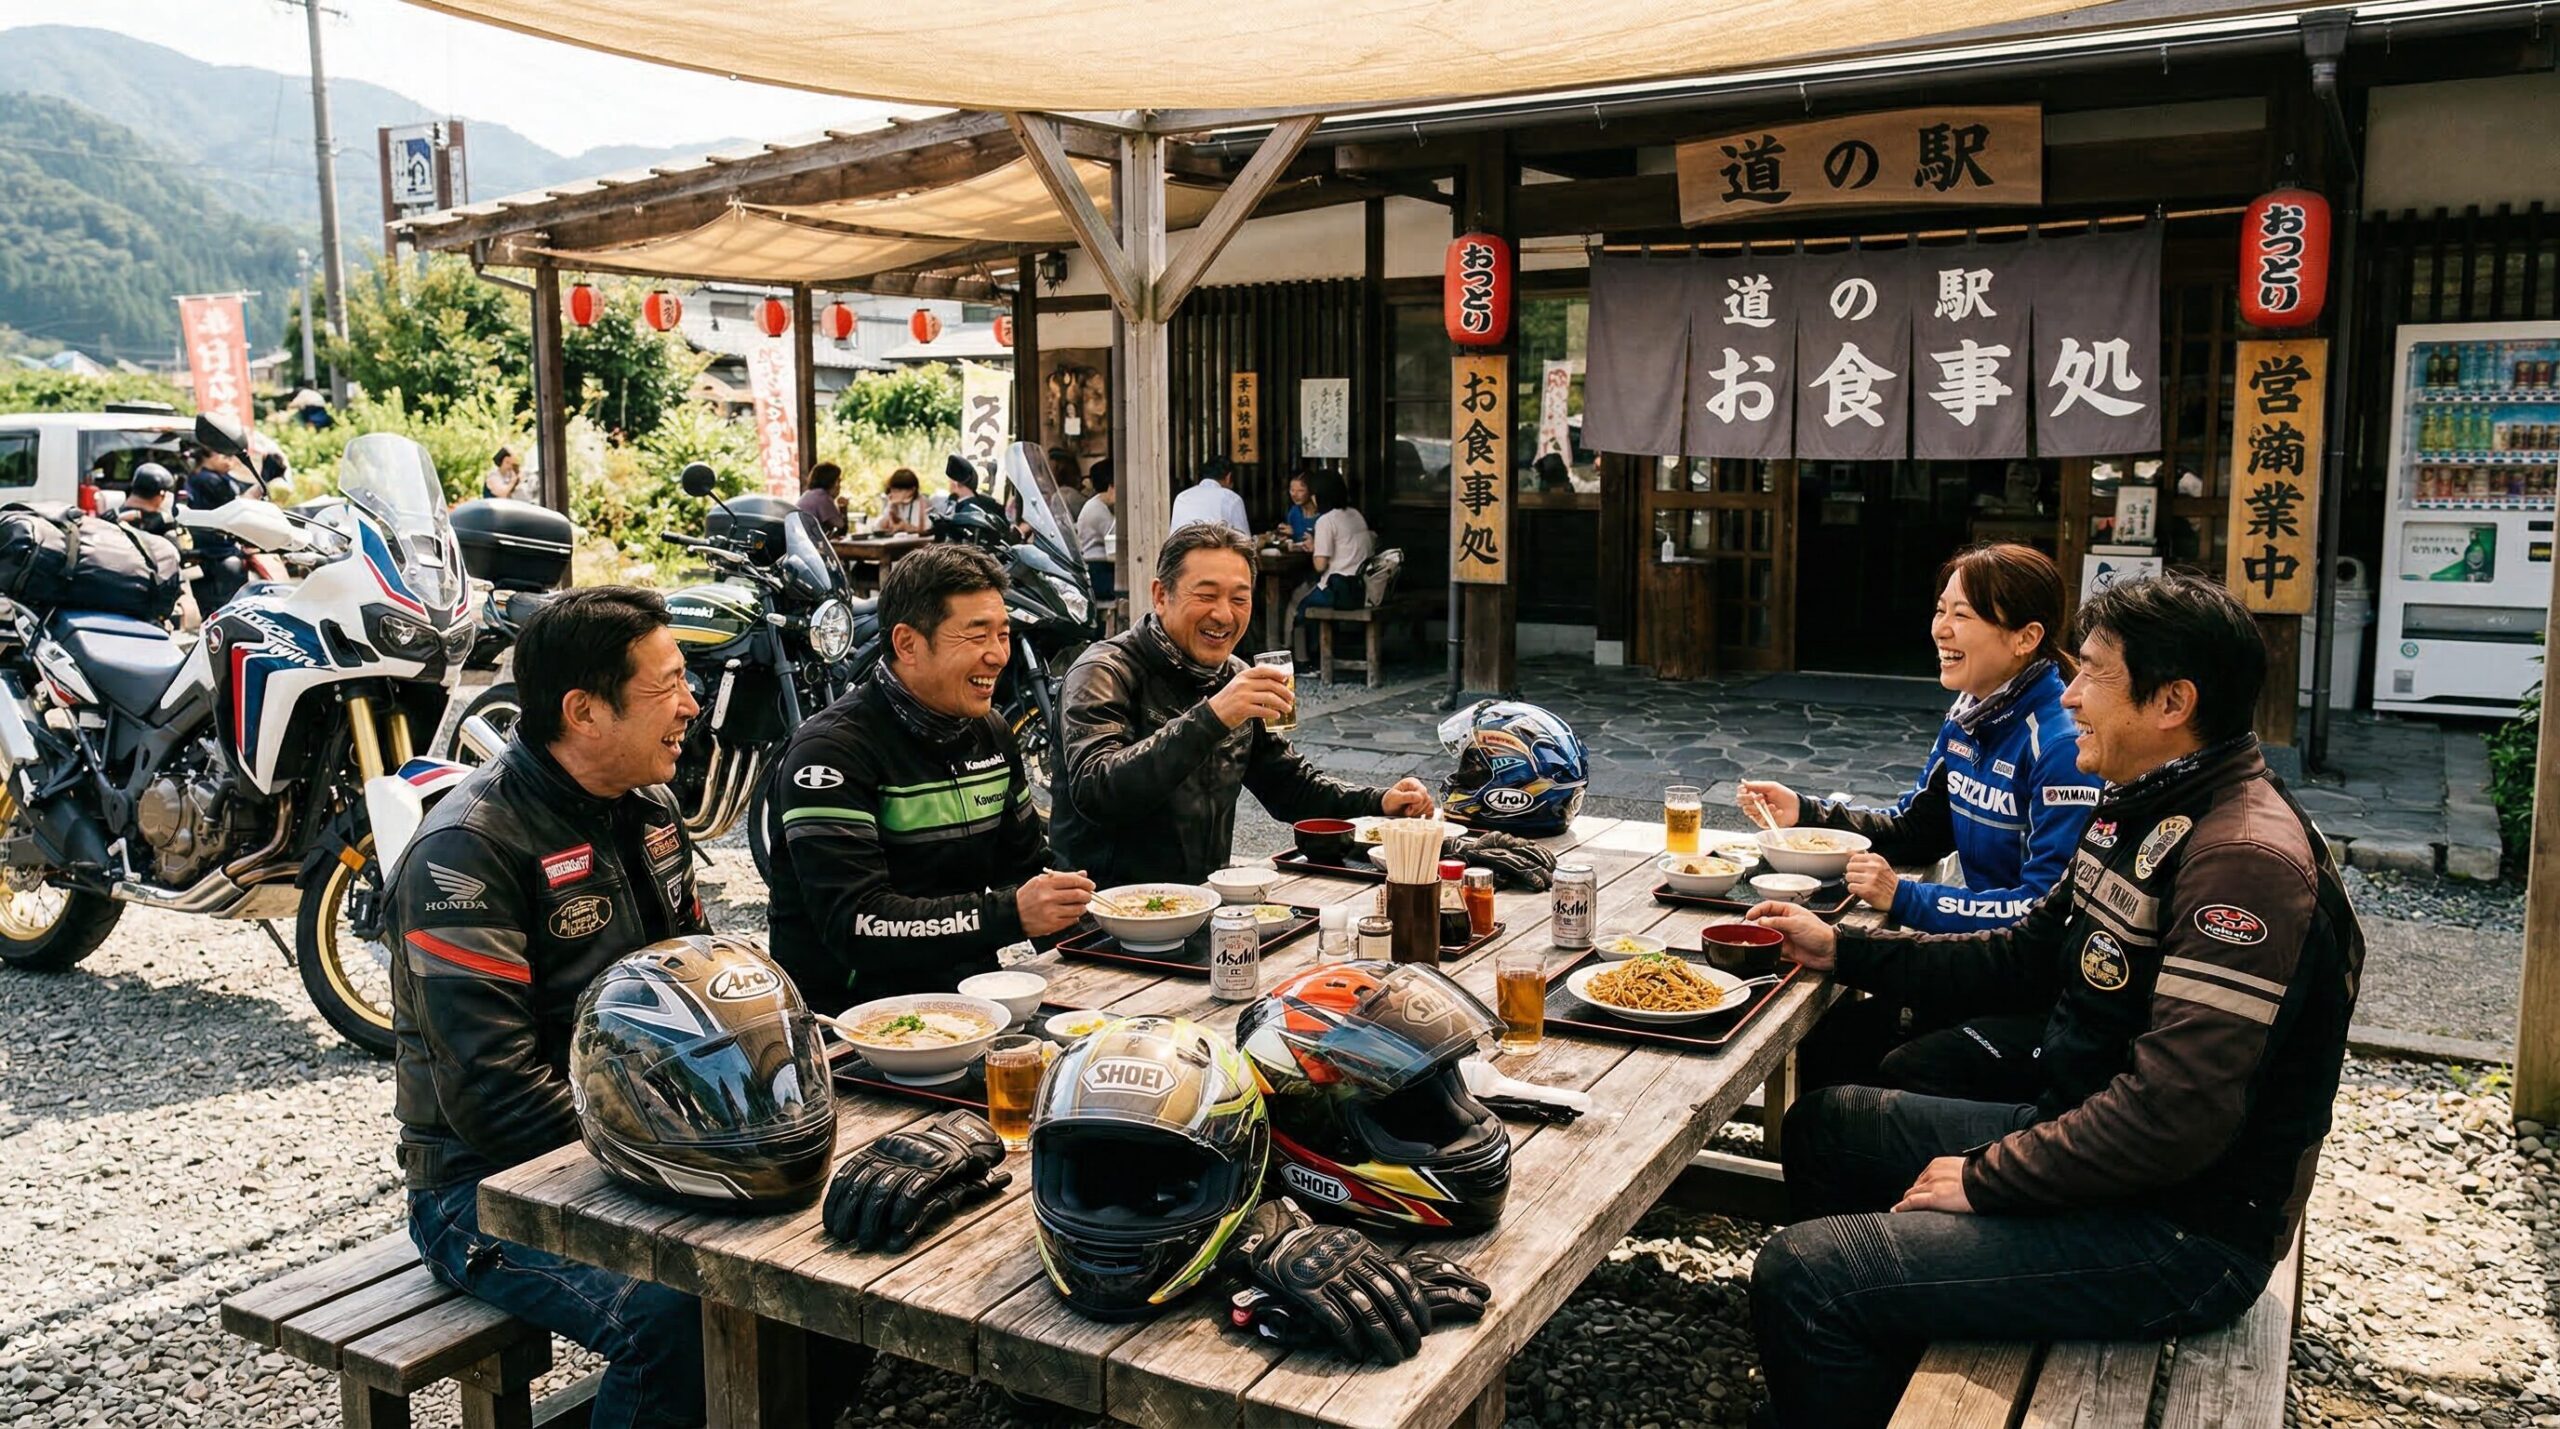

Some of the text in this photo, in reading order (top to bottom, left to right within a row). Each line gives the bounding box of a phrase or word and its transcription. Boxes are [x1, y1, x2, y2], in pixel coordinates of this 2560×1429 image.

[1720, 122, 1994, 204] 道の駅
[1723, 268, 1998, 328] 道の駅
[1705, 337, 2147, 428] お食事処
[1457, 370, 1501, 566] お食事処
[1947, 770, 2018, 817] SUZUKI
[425, 900, 489, 911] HONDA
[1552, 898, 1589, 917] Asahi
[1937, 896, 2034, 919] SUZUK
[854, 908, 981, 938] Kawasaki
[1215, 946, 1256, 966] Asahi
[1093, 1064, 1164, 1090] SHOEI
[1291, 1169, 1340, 1200] SHOEI
